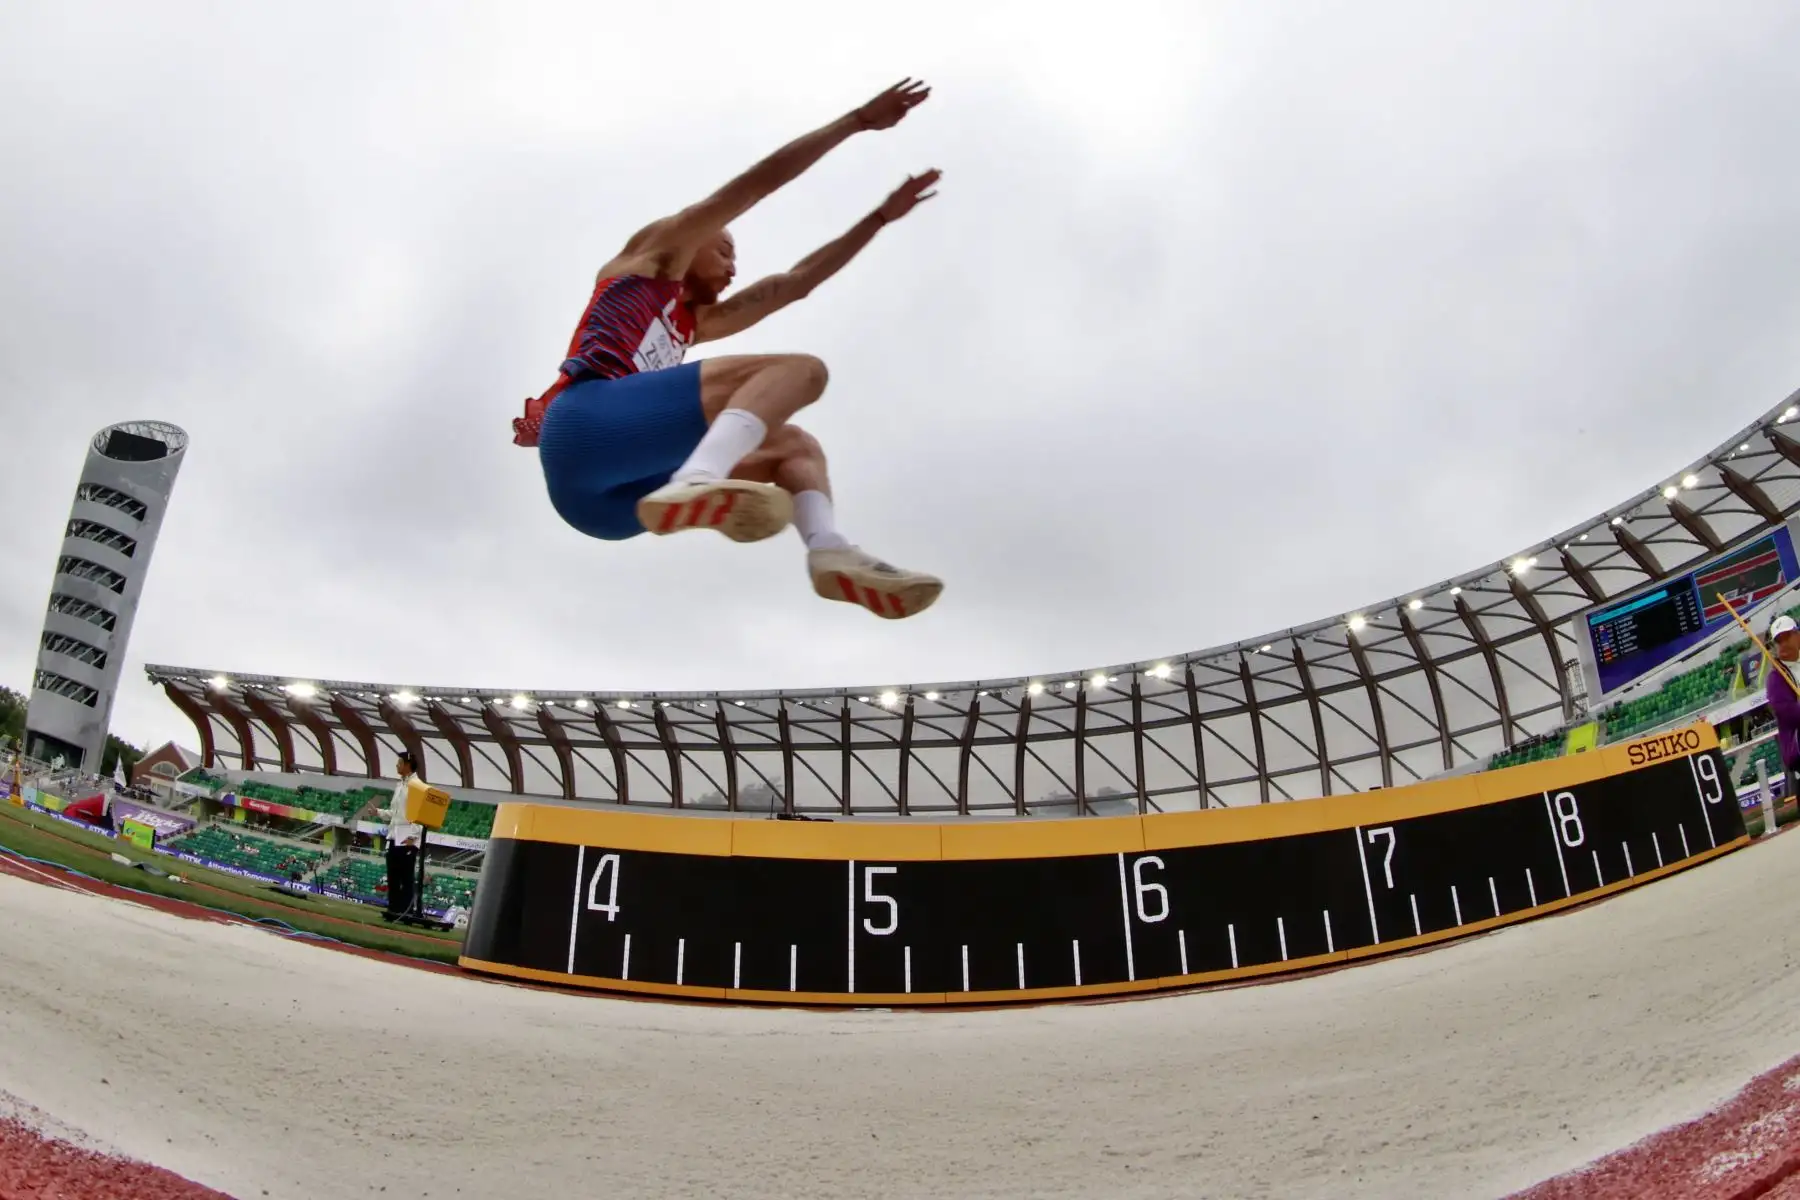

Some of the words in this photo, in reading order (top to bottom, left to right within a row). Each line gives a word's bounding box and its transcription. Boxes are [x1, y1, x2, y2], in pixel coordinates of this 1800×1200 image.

[1627, 729, 1700, 766] SEIKO
[1697, 754, 1723, 804] 9
[1554, 791, 1585, 848] 8
[587, 853, 621, 922] 4
[1133, 855, 1170, 923] 6
[1367, 826, 1396, 889] 7
[863, 866, 898, 936] 5
